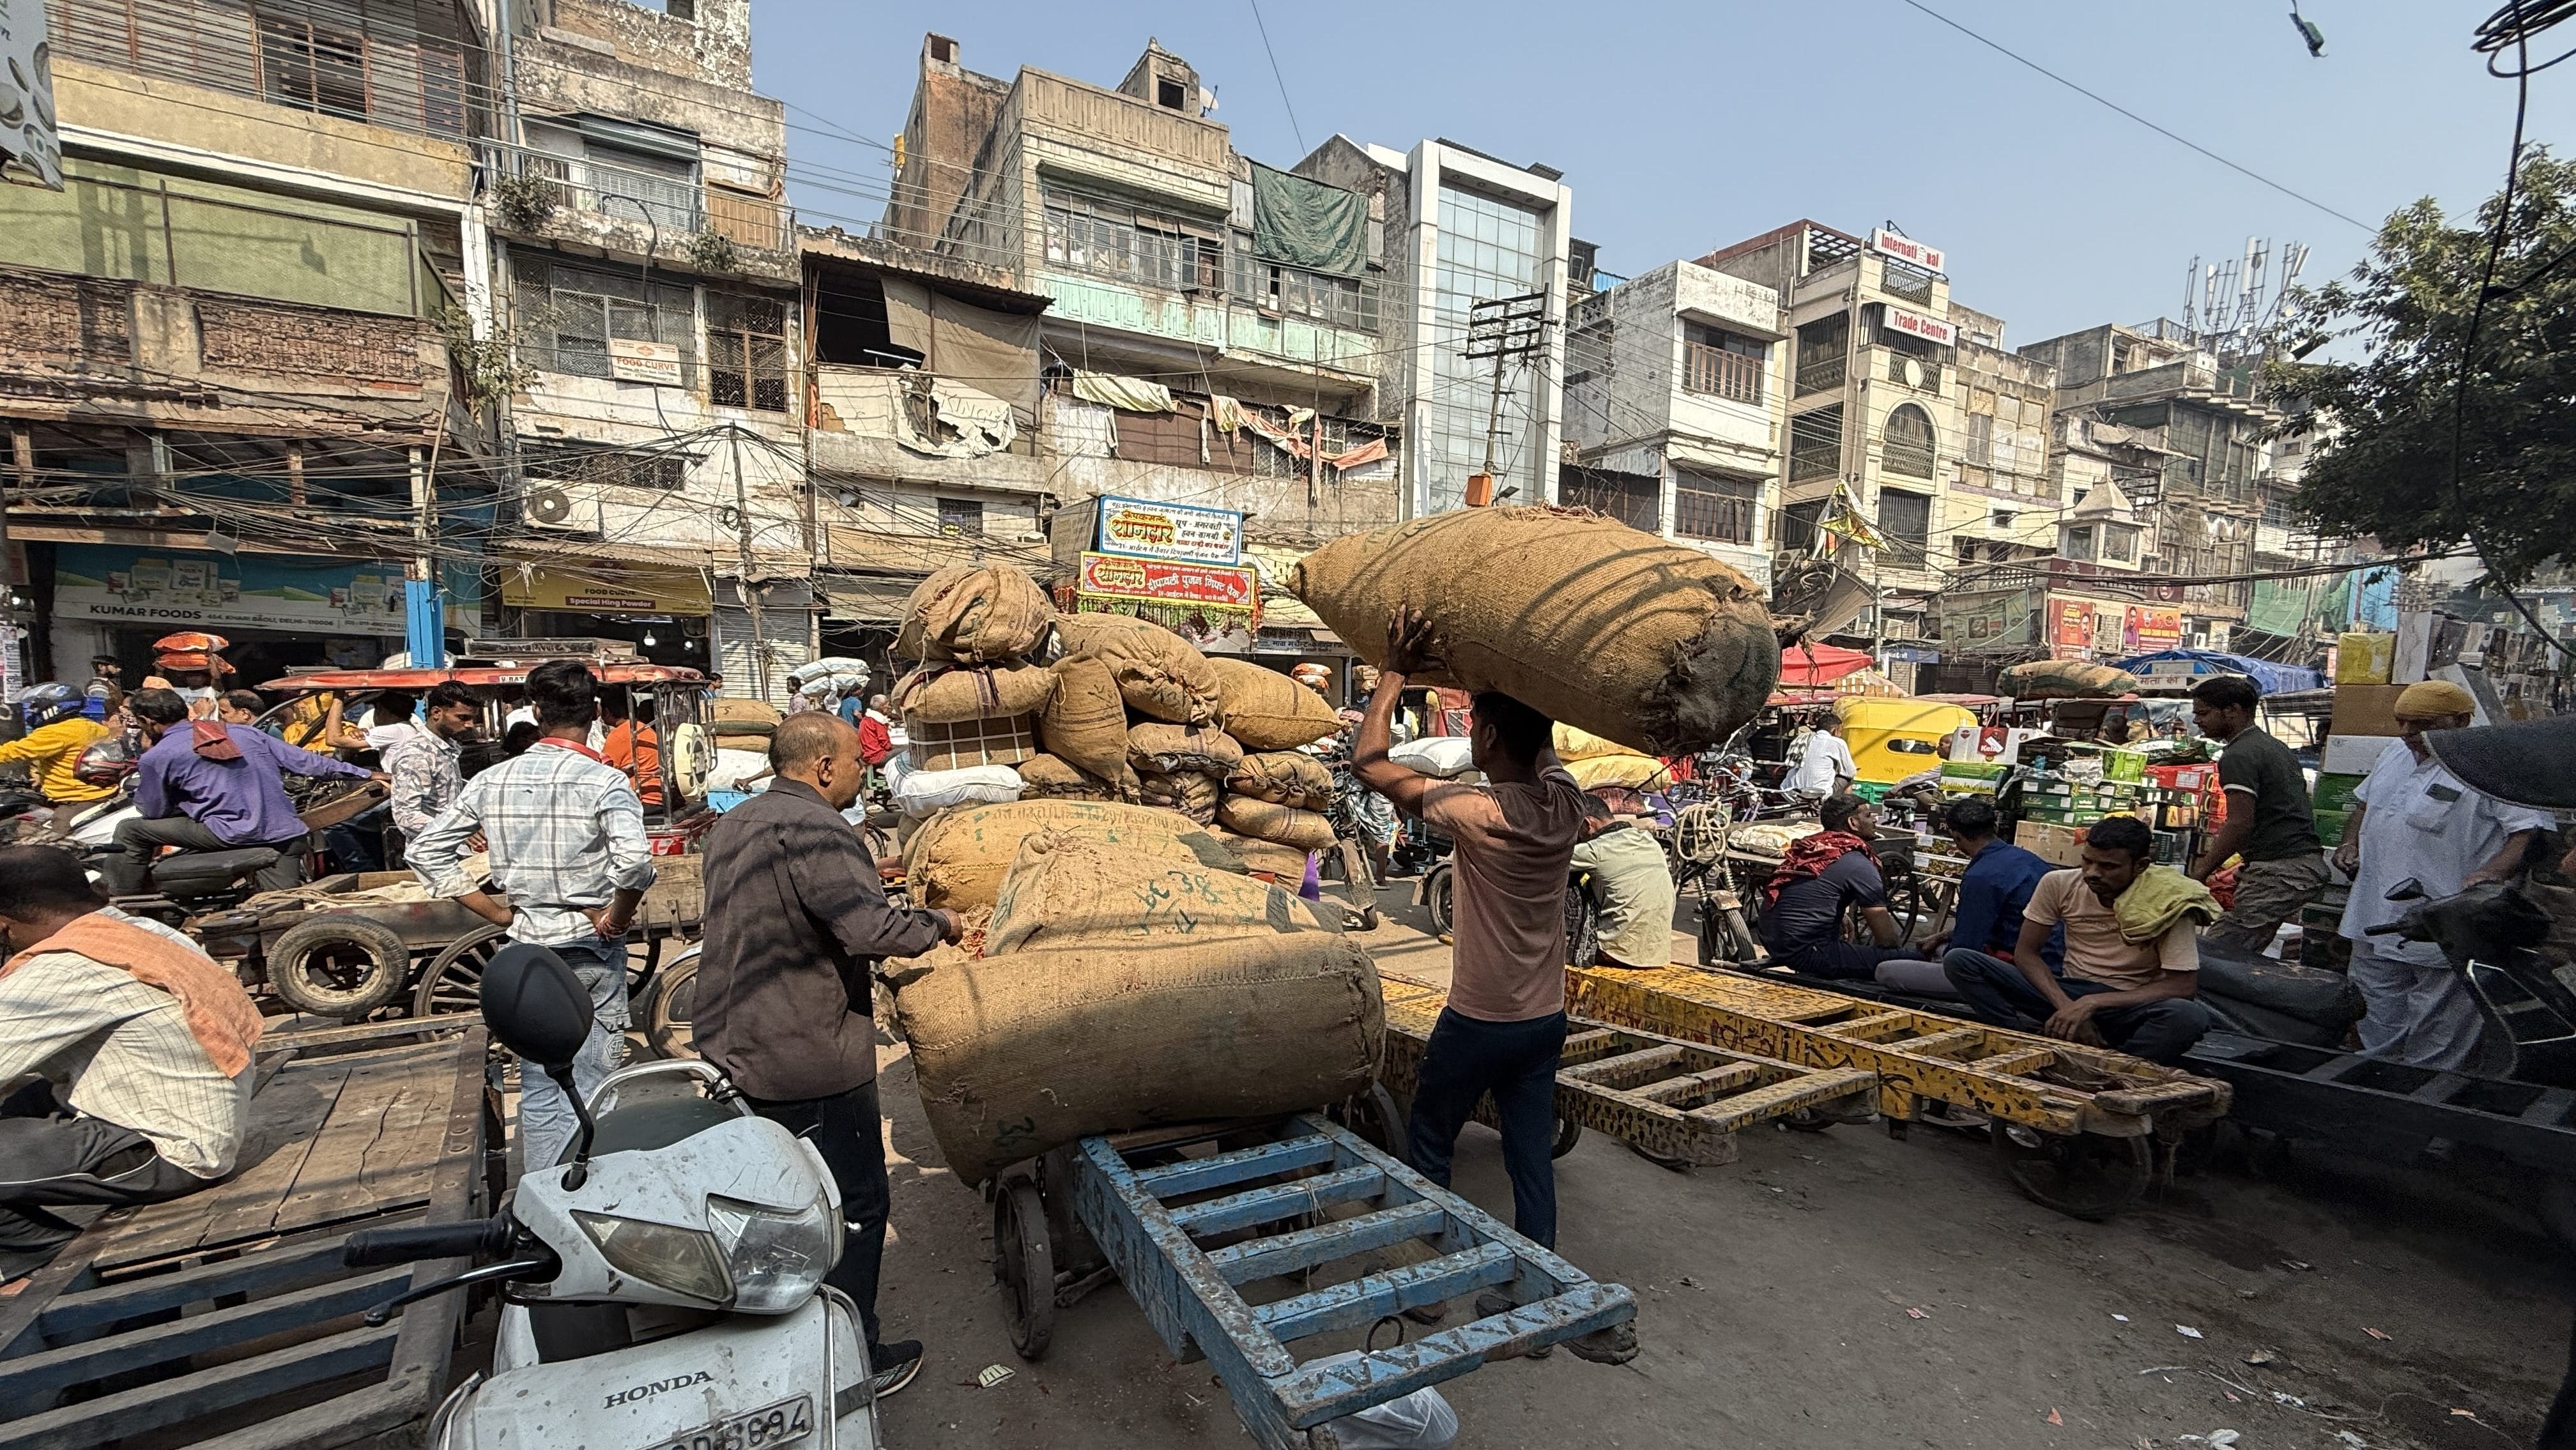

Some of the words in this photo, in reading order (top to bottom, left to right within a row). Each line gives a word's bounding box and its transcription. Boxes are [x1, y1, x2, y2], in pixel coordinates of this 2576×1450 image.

[1894, 310, 1918, 332] Trade
[1920, 319, 1947, 340] Centre
[617, 357, 642, 367] FOOD
[645, 360, 676, 371] CURVE
[1112, 519, 1174, 543] शानदार
[1096, 568, 1144, 586] शानदार
[601, 599, 620, 607] Hing
[90, 605, 146, 617] KUMAR
[150, 608, 202, 620] FOODS
[2140, 676, 2161, 685] माता
[604, 1371, 714, 1410] HONDA
